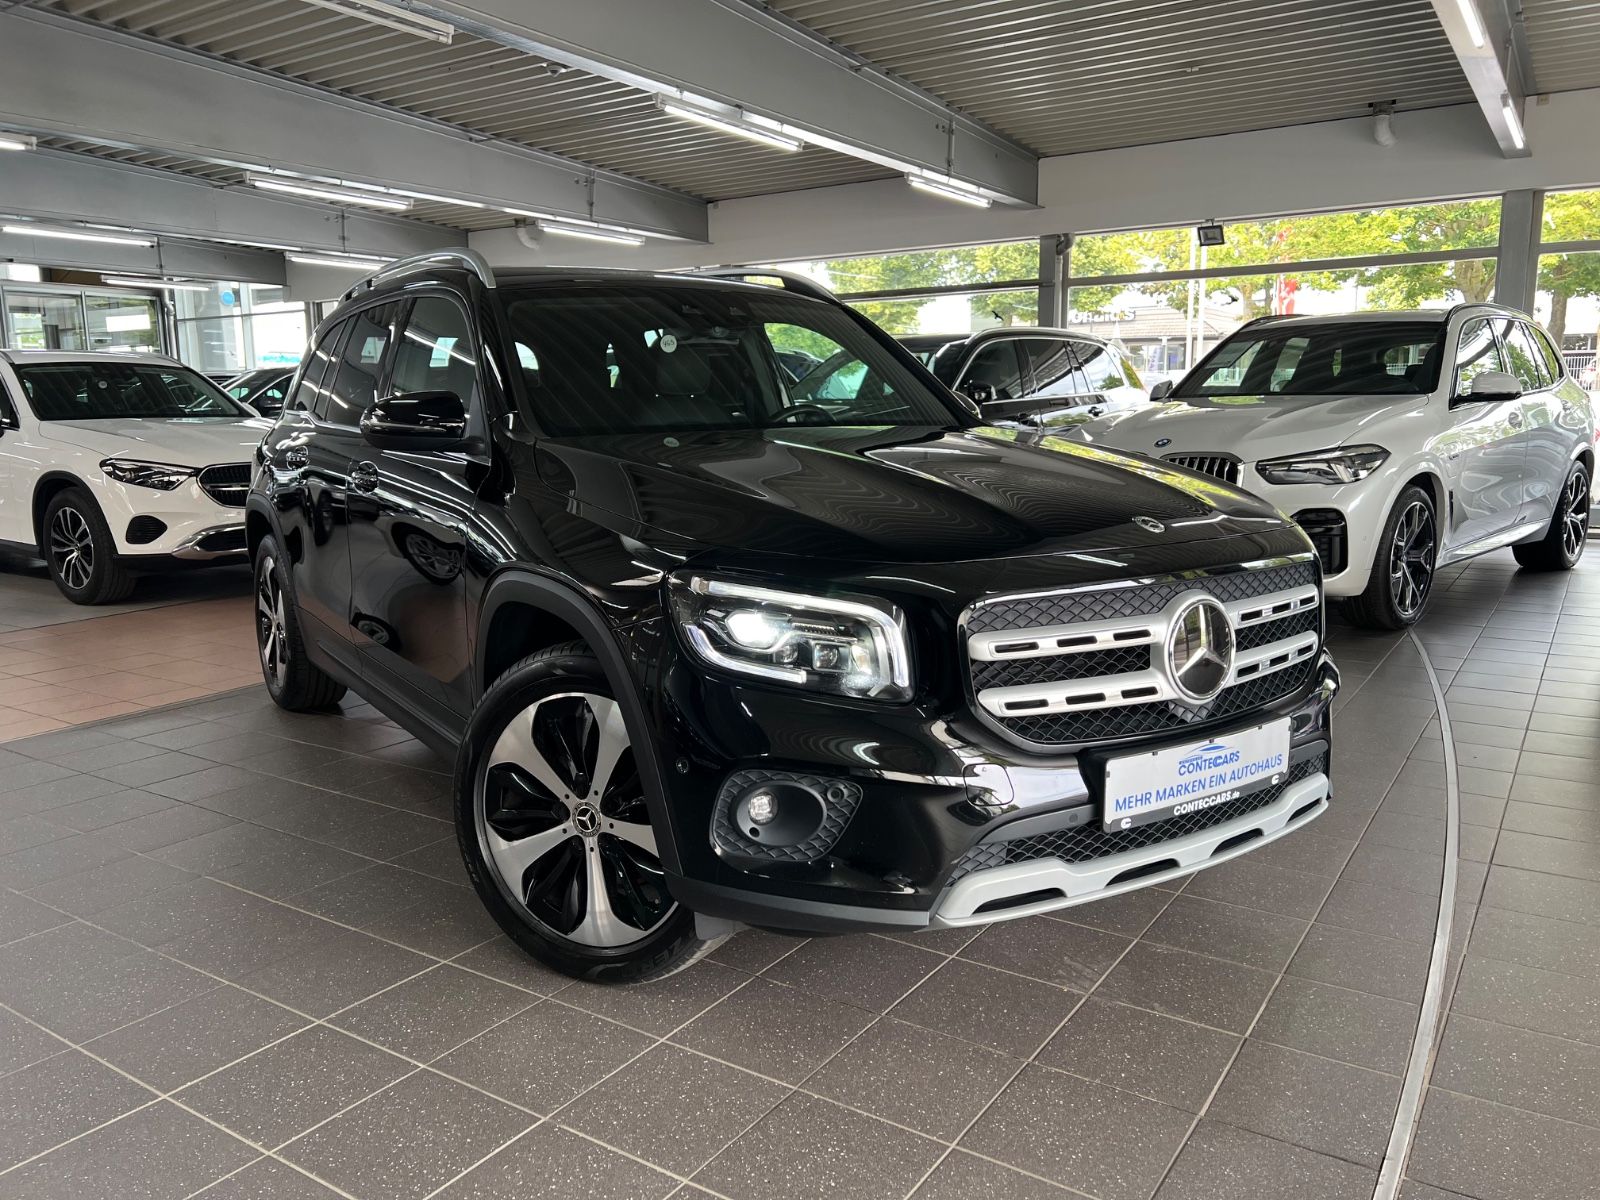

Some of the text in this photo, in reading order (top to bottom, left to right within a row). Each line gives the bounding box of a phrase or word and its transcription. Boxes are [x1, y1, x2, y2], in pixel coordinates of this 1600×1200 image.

[1115, 753, 1283, 812] MEHR MARKEN EIN AUTOHAUS
[1173, 790, 1240, 816] CONTECCARS.de
